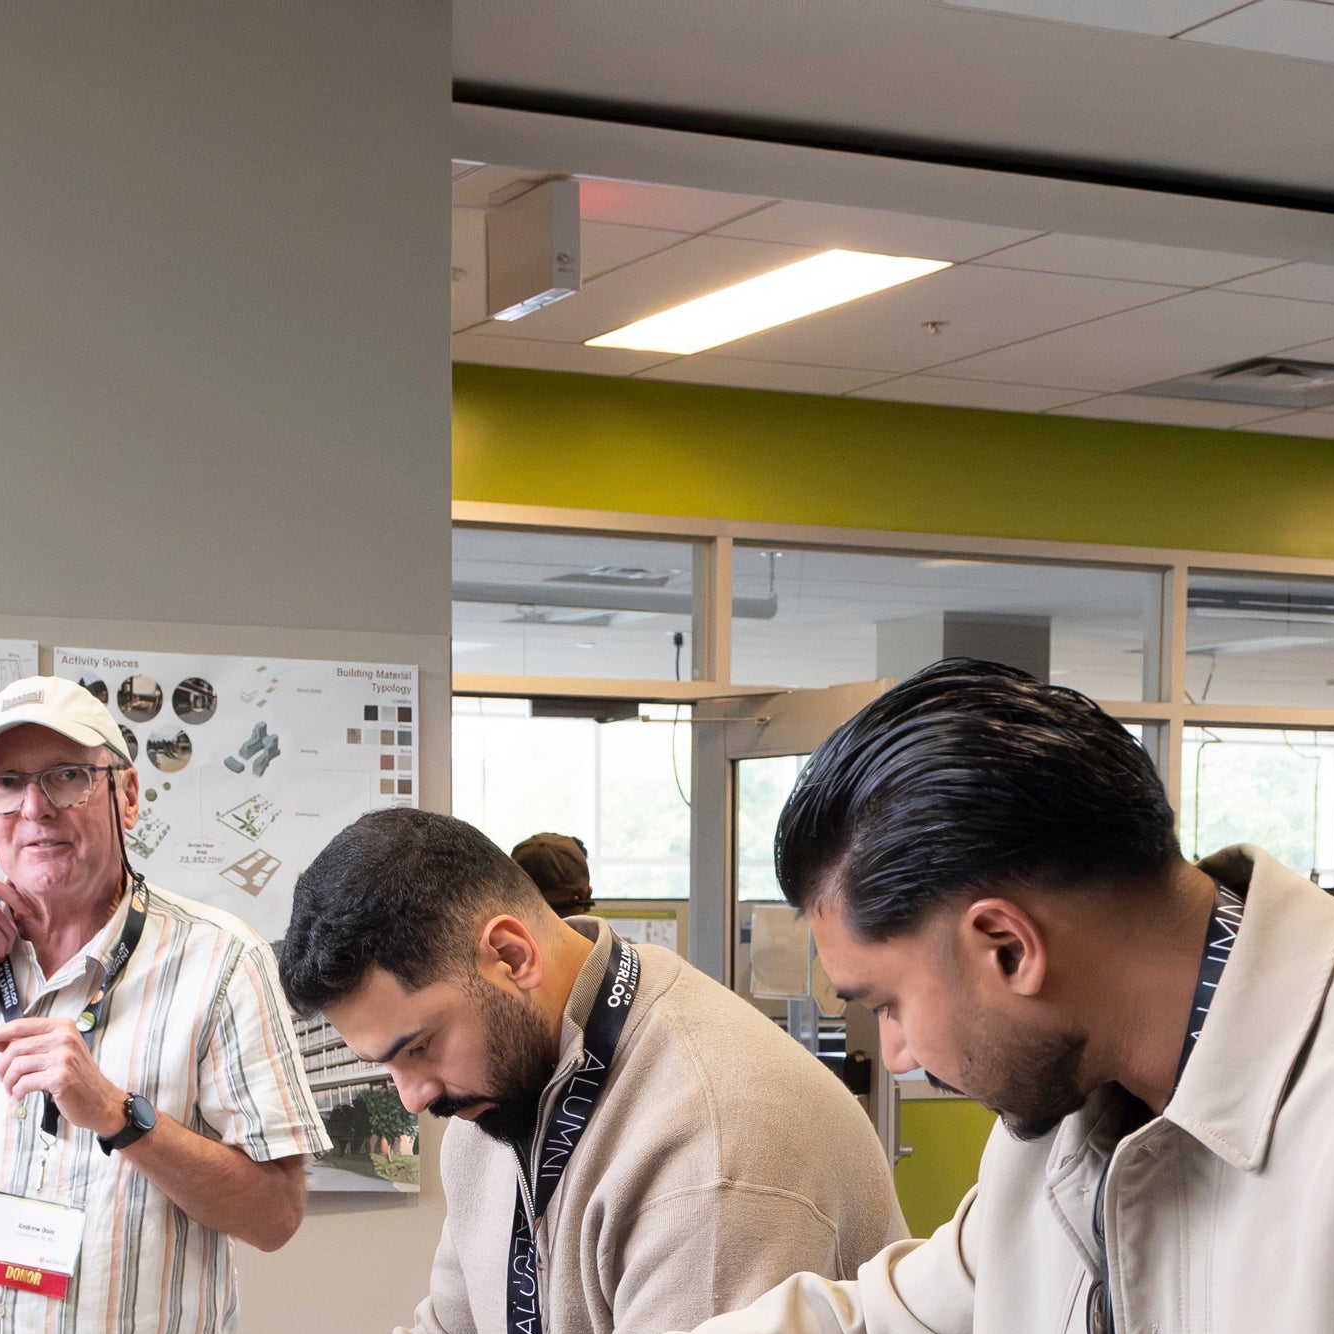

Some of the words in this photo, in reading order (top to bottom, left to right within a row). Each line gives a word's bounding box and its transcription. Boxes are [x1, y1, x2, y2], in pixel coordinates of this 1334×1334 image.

[61, 655, 100, 668] Activity
[102, 657, 139, 668] Spaces
[336, 667, 373, 680] Building
[375, 670, 412, 680] Material
[371, 683, 412, 695] Typology
[3, 960, 18, 1006] WATERLOO
[607, 941, 631, 1008] WATERLOO
[623, 993, 632, 1006] OF
[540, 1048, 606, 1178] ALUMNI
[5, 1265, 43, 1286] DONOR
